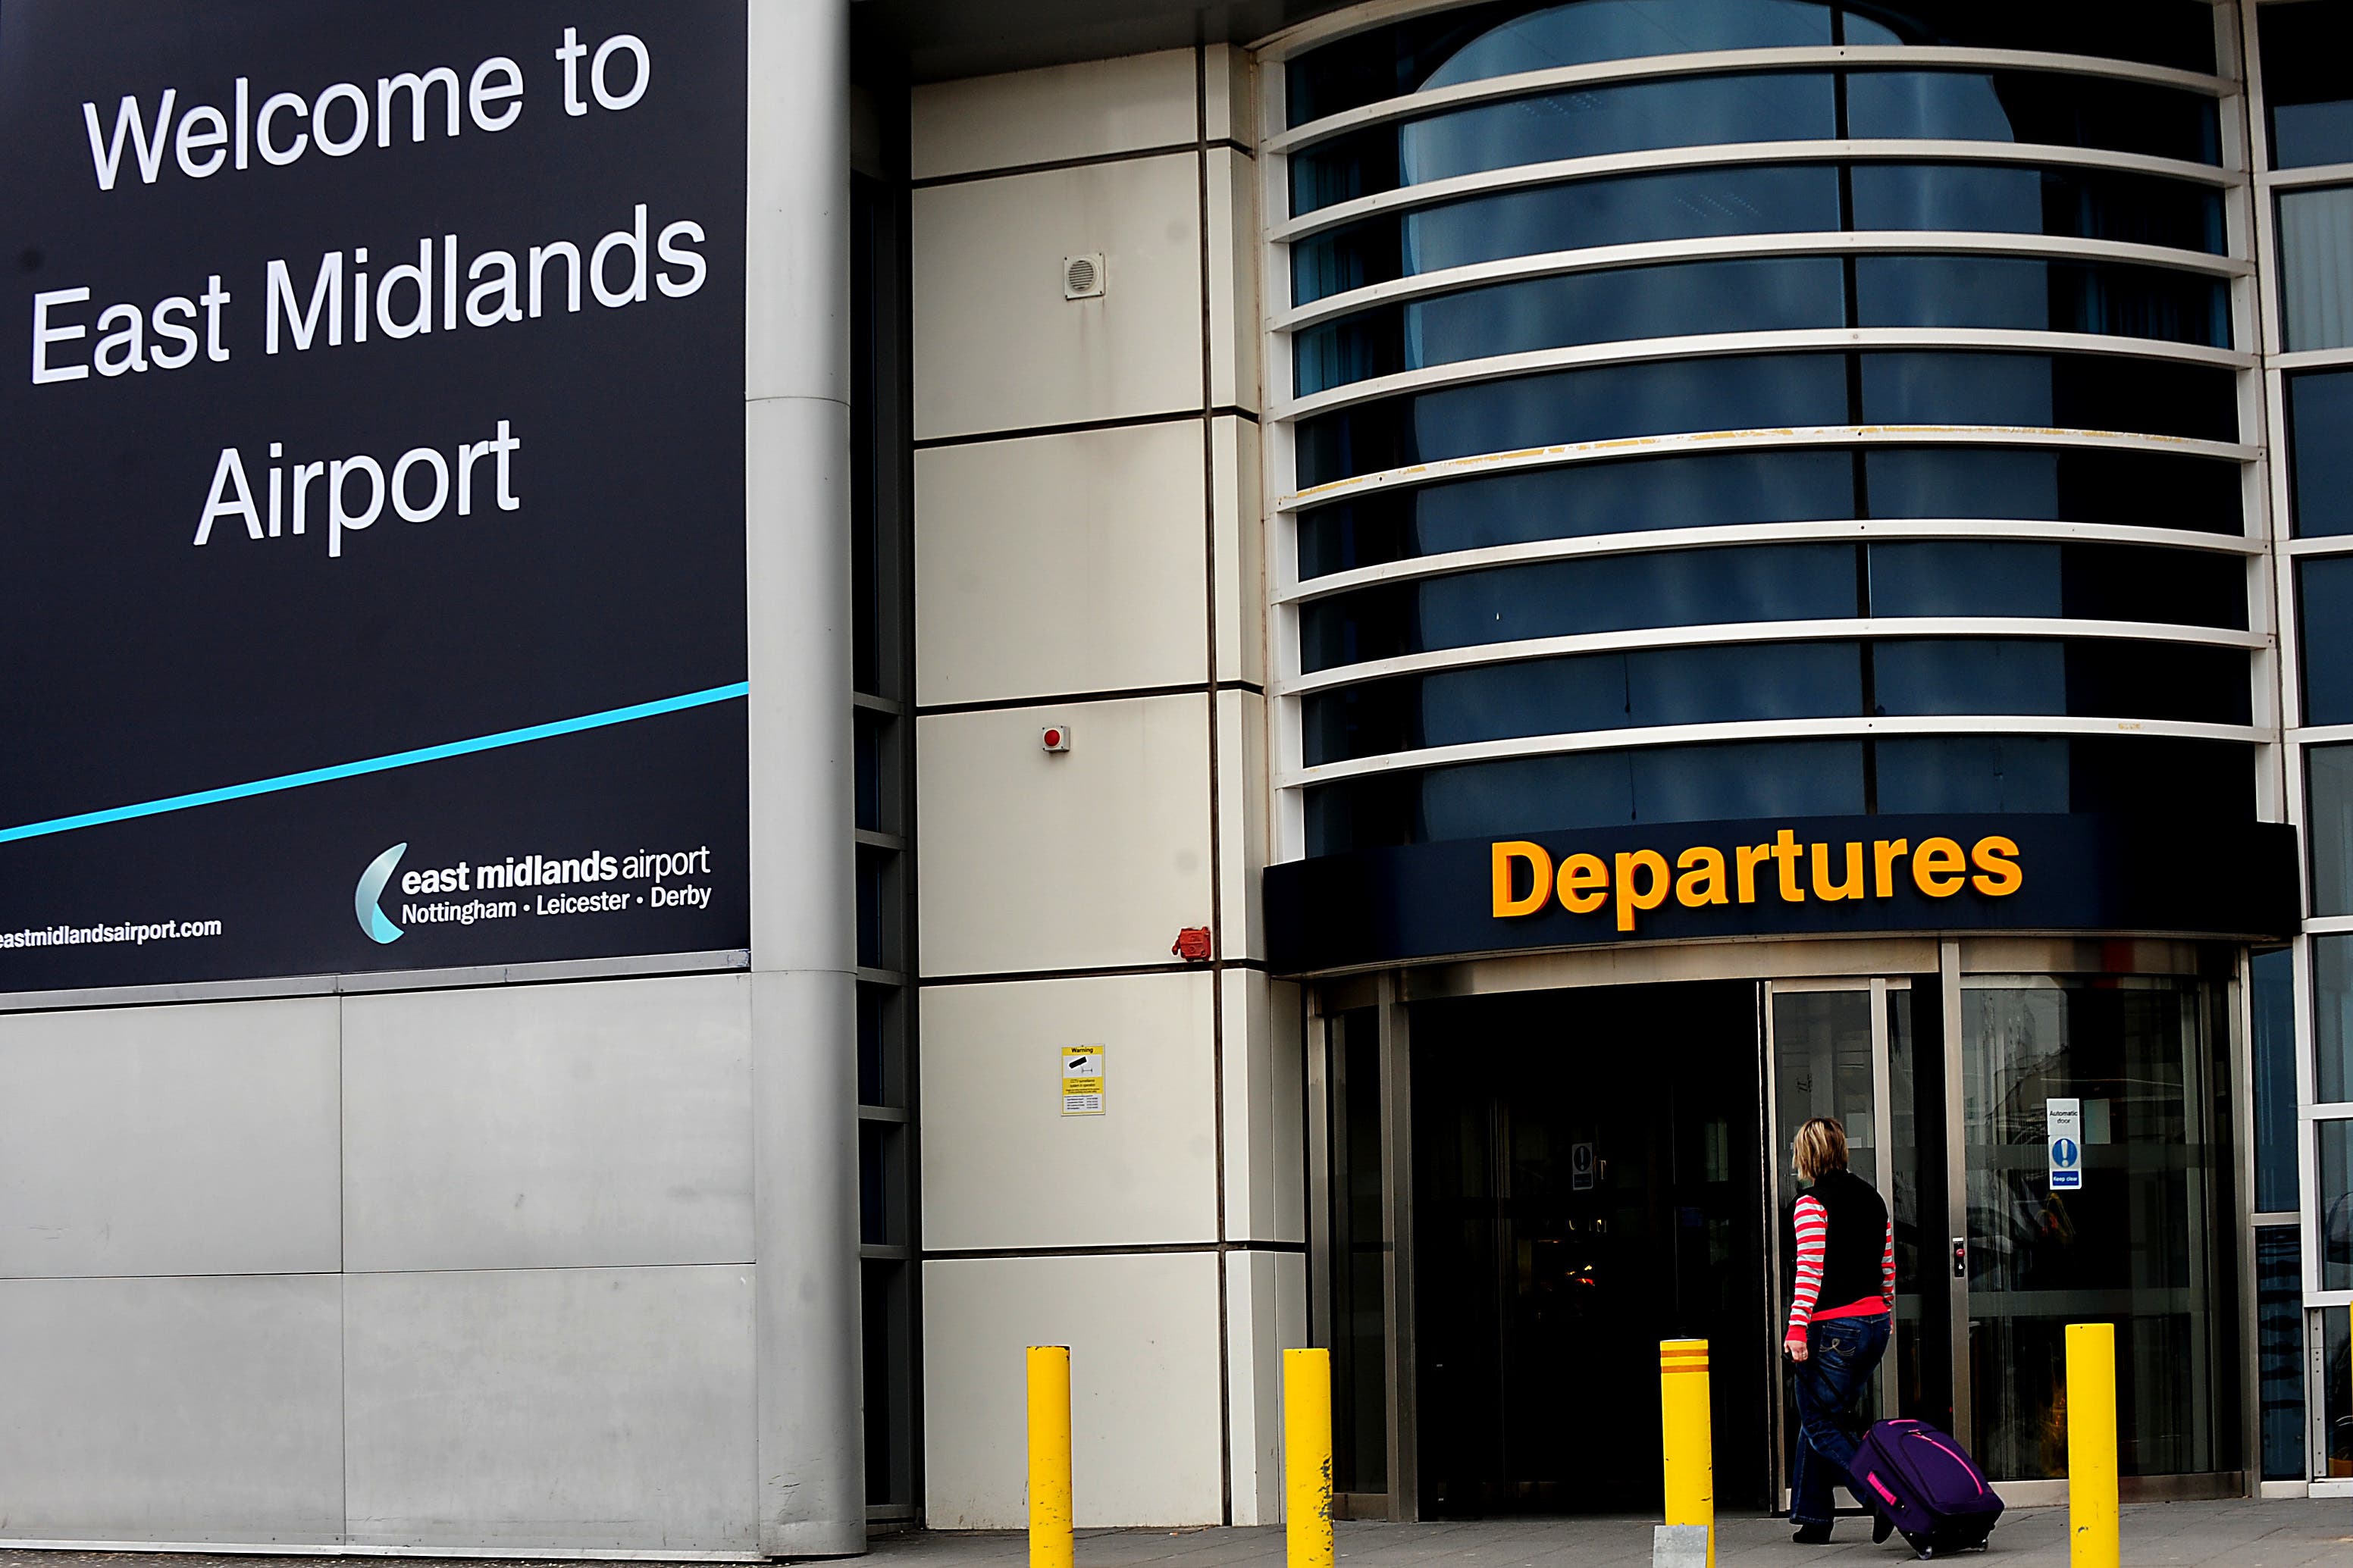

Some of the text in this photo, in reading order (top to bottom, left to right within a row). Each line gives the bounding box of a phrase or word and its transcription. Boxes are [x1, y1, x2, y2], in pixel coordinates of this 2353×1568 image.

[83, 27, 650, 191] Welcome to
[32, 204, 707, 385] East Midlands
[193, 420, 520, 558] Airport
[401, 845, 712, 895] east midlands airport
[402, 884, 712, 925] Nottingham Leicester Derby
[1491, 829, 2023, 931] Departures
